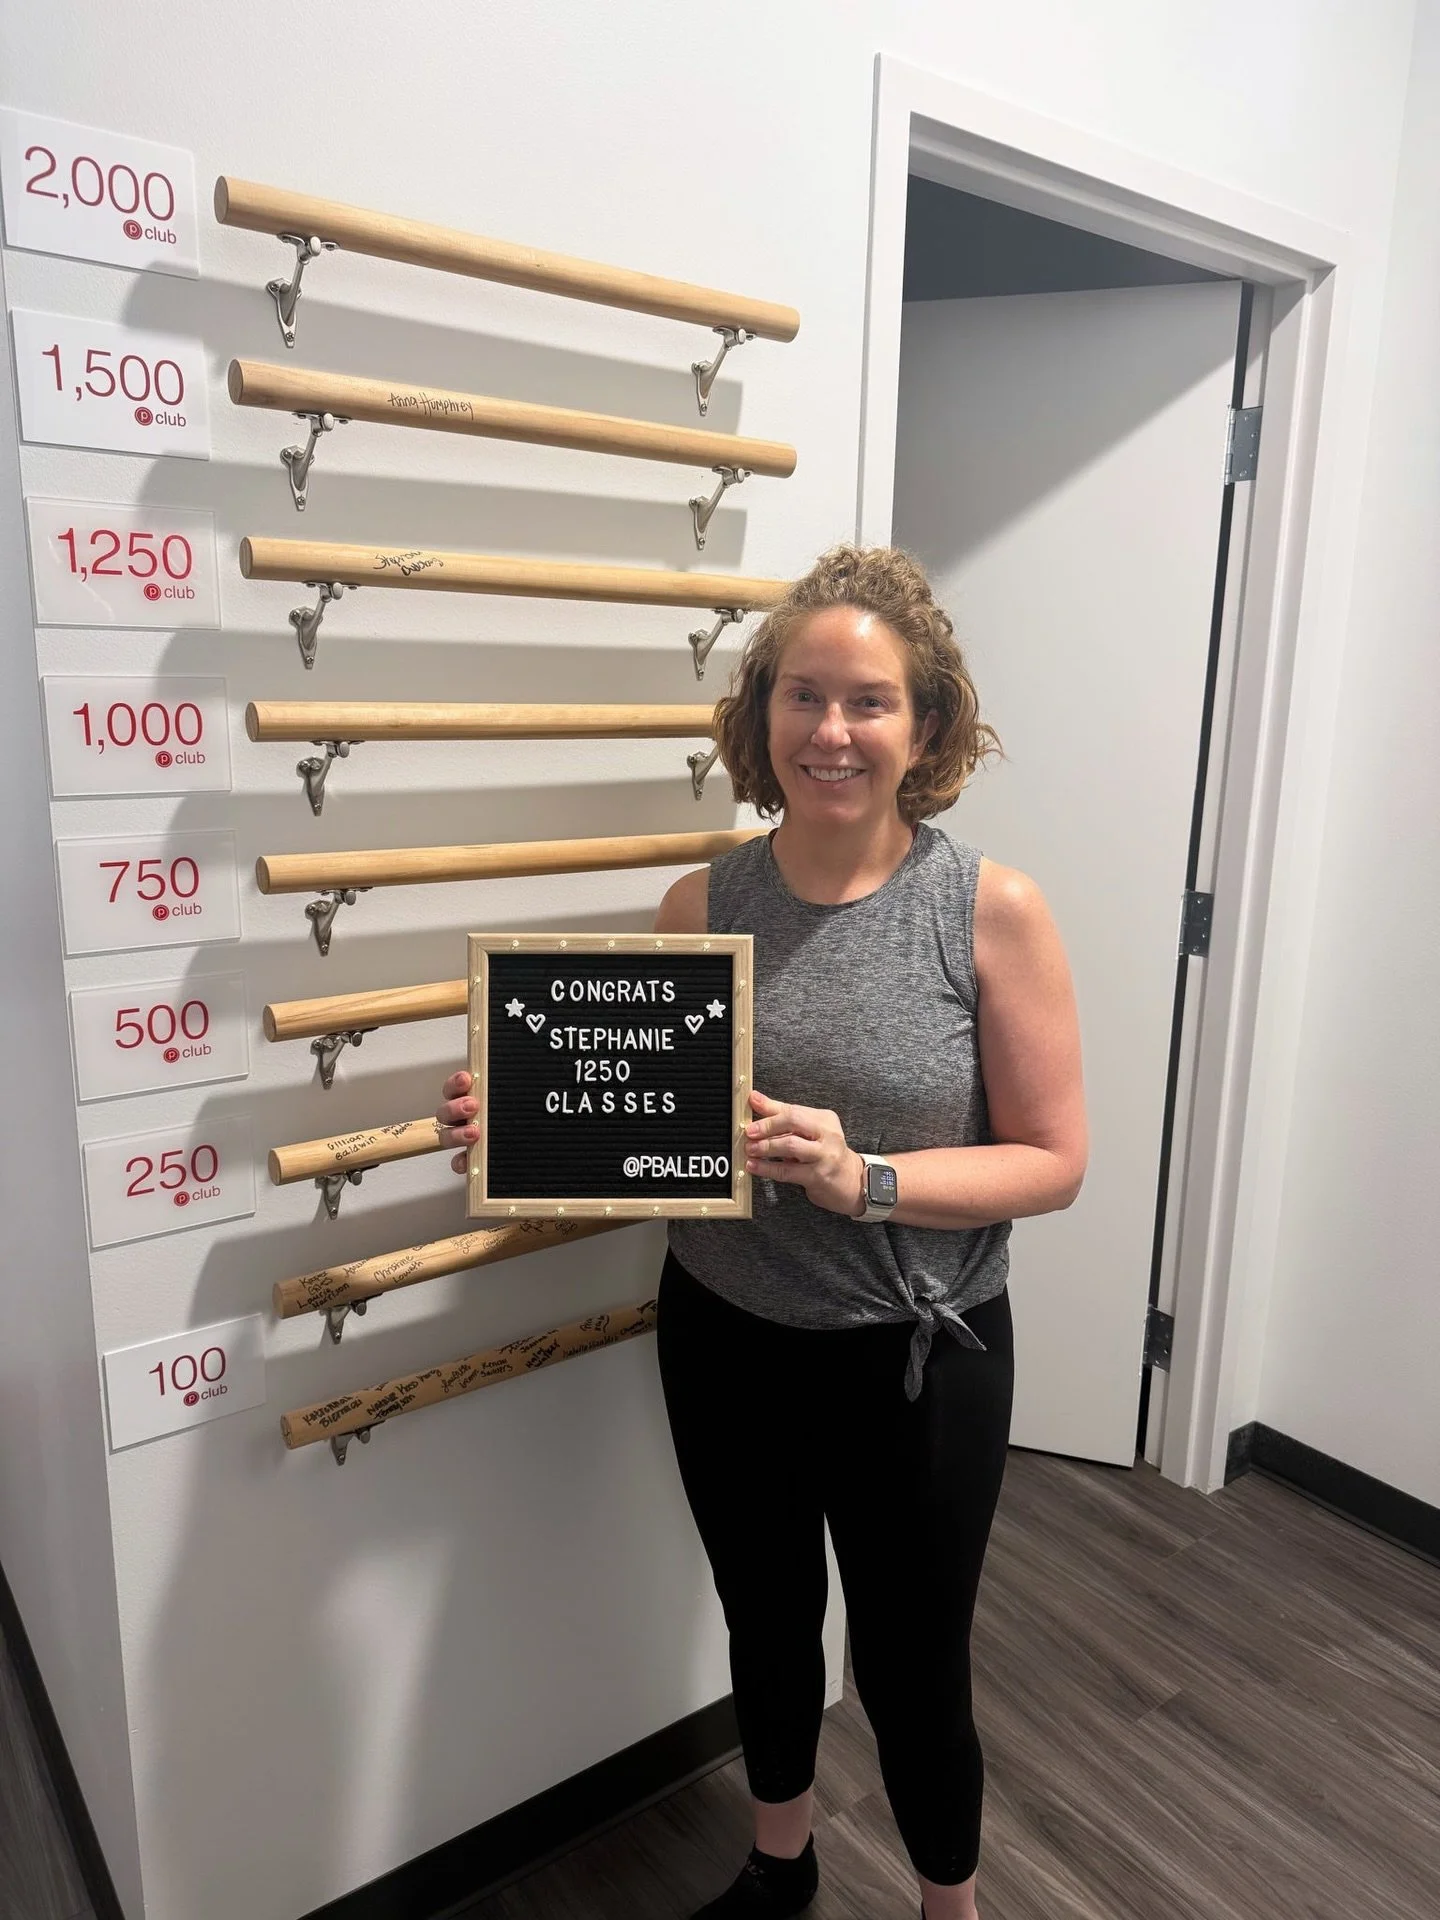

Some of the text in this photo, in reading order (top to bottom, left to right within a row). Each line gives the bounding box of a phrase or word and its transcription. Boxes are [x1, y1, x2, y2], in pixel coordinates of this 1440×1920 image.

[25, 146, 174, 221] 2,000
[144, 226, 177, 244] club
[42, 344, 184, 406] 1,500
[387, 392, 474, 421] Anna Humphrey
[155, 411, 187, 427] club
[57, 527, 193, 583] 1,250
[164, 586, 195, 599] club
[73, 702, 203, 755] 1,000
[175, 751, 206, 765] club
[99, 857, 200, 903] 750
[172, 903, 203, 917] club
[551, 980, 675, 1002] CONGRATS
[115, 1000, 210, 1049] 500
[550, 1026, 674, 1051] STEPHANIE
[182, 1044, 212, 1058] club
[575, 1059, 630, 1083] 1250
[546, 1092, 676, 1113] CLASSES
[335, 1135, 377, 1161] Baldwin
[125, 1144, 219, 1197] 250
[623, 1156, 729, 1178] @PBALEDO
[192, 1186, 221, 1202] club
[148, 1347, 226, 1396] 100
[200, 1384, 228, 1400] club
